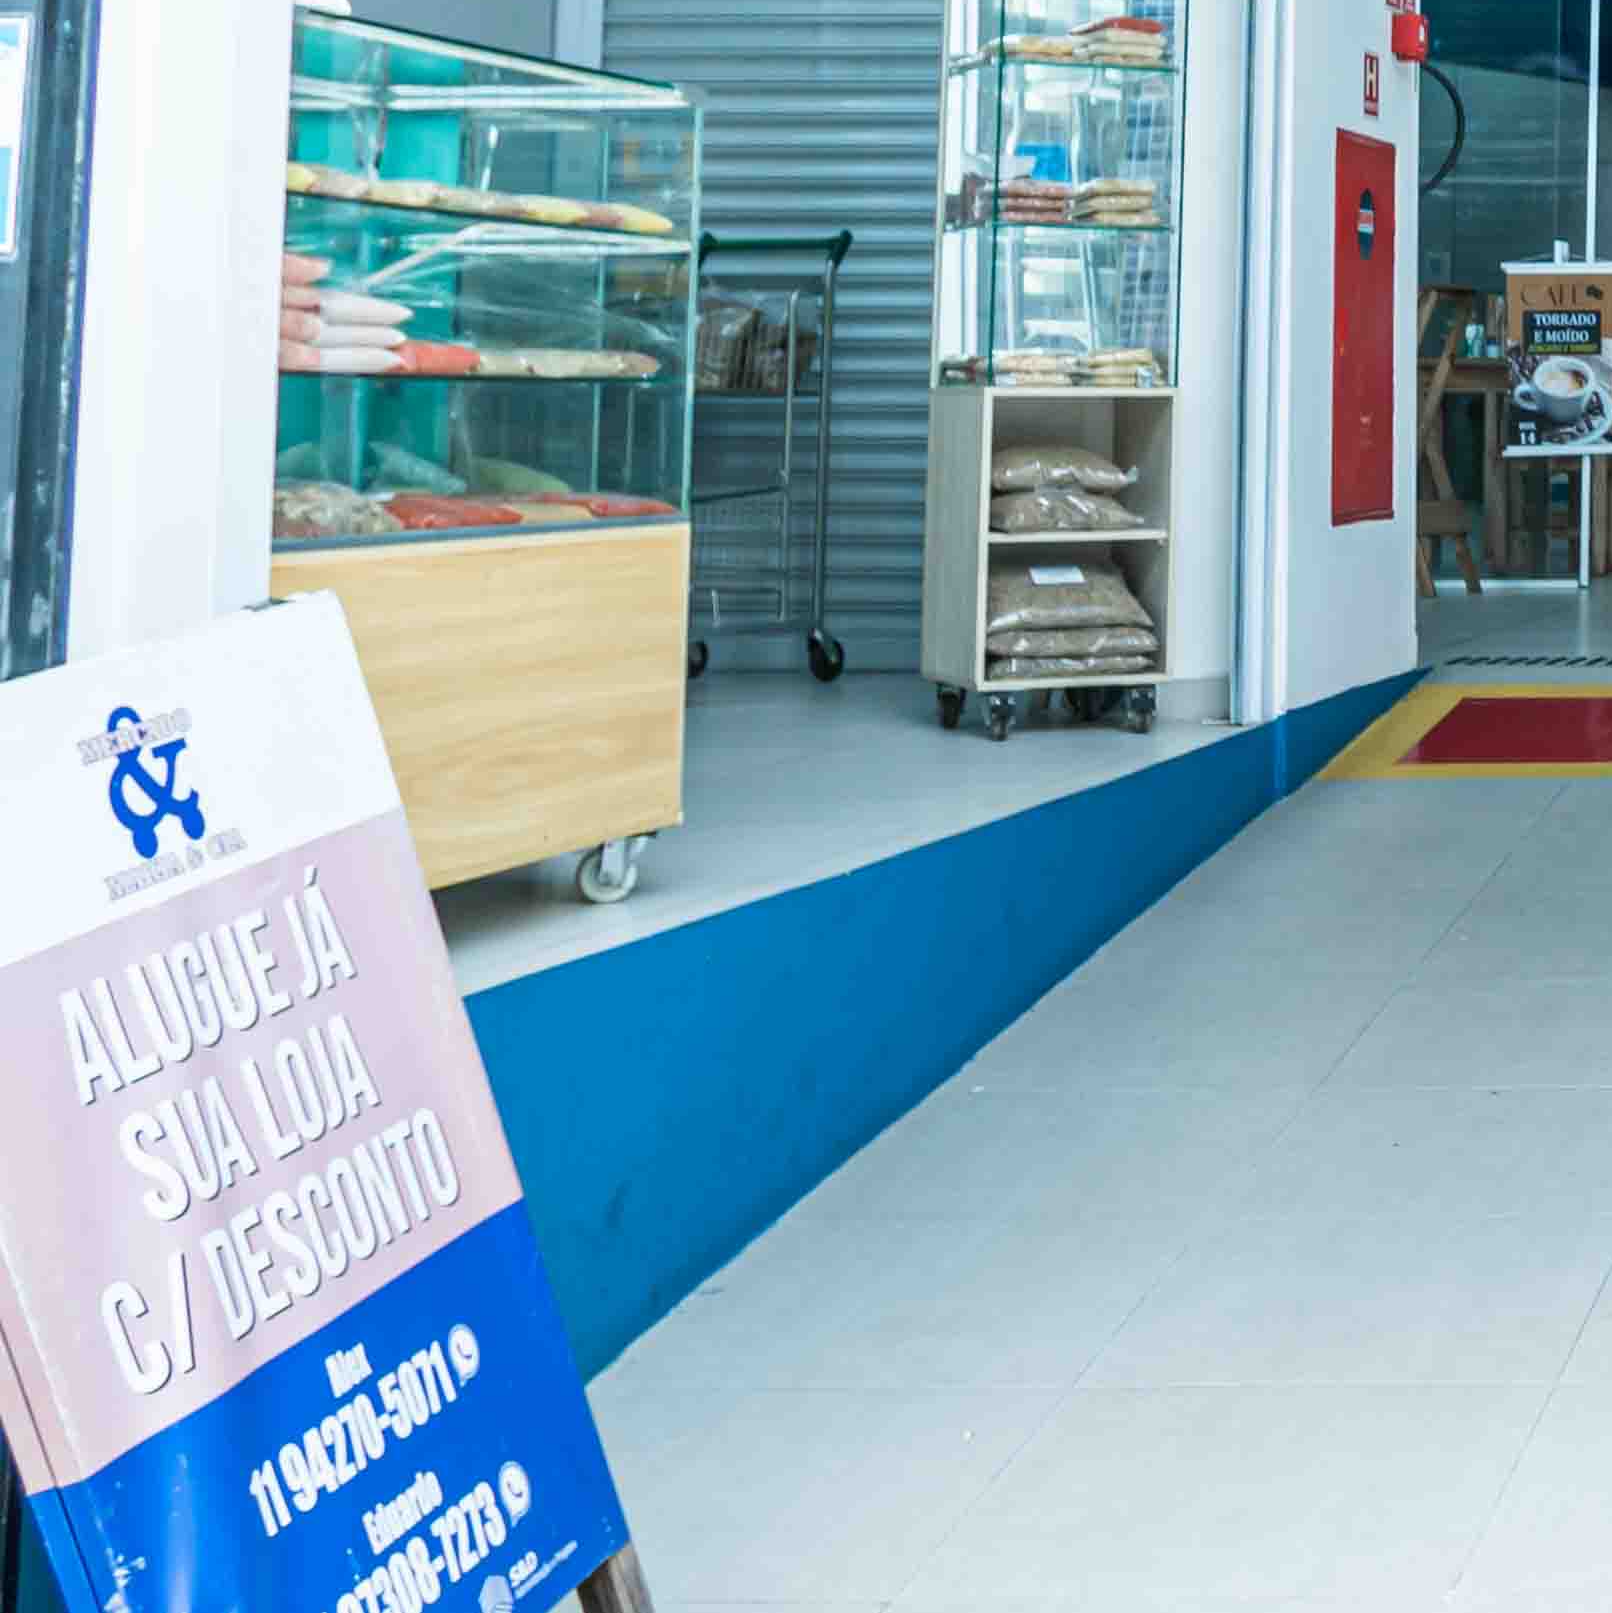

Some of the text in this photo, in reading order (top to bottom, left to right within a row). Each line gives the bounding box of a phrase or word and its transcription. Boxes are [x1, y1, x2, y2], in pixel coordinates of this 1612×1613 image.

[1534, 313, 1597, 326] TORRADO
[1545, 329, 1590, 343] MOÍDO
[59, 864, 358, 1107] ALUGUE JÁ
[119, 1012, 382, 1222] SUA LOJA
[101, 1107, 462, 1396] C/ DESCONTO
[249, 1339, 457, 1538] 11 94270-5071
[362, 1470, 444, 1556] Eduardo
